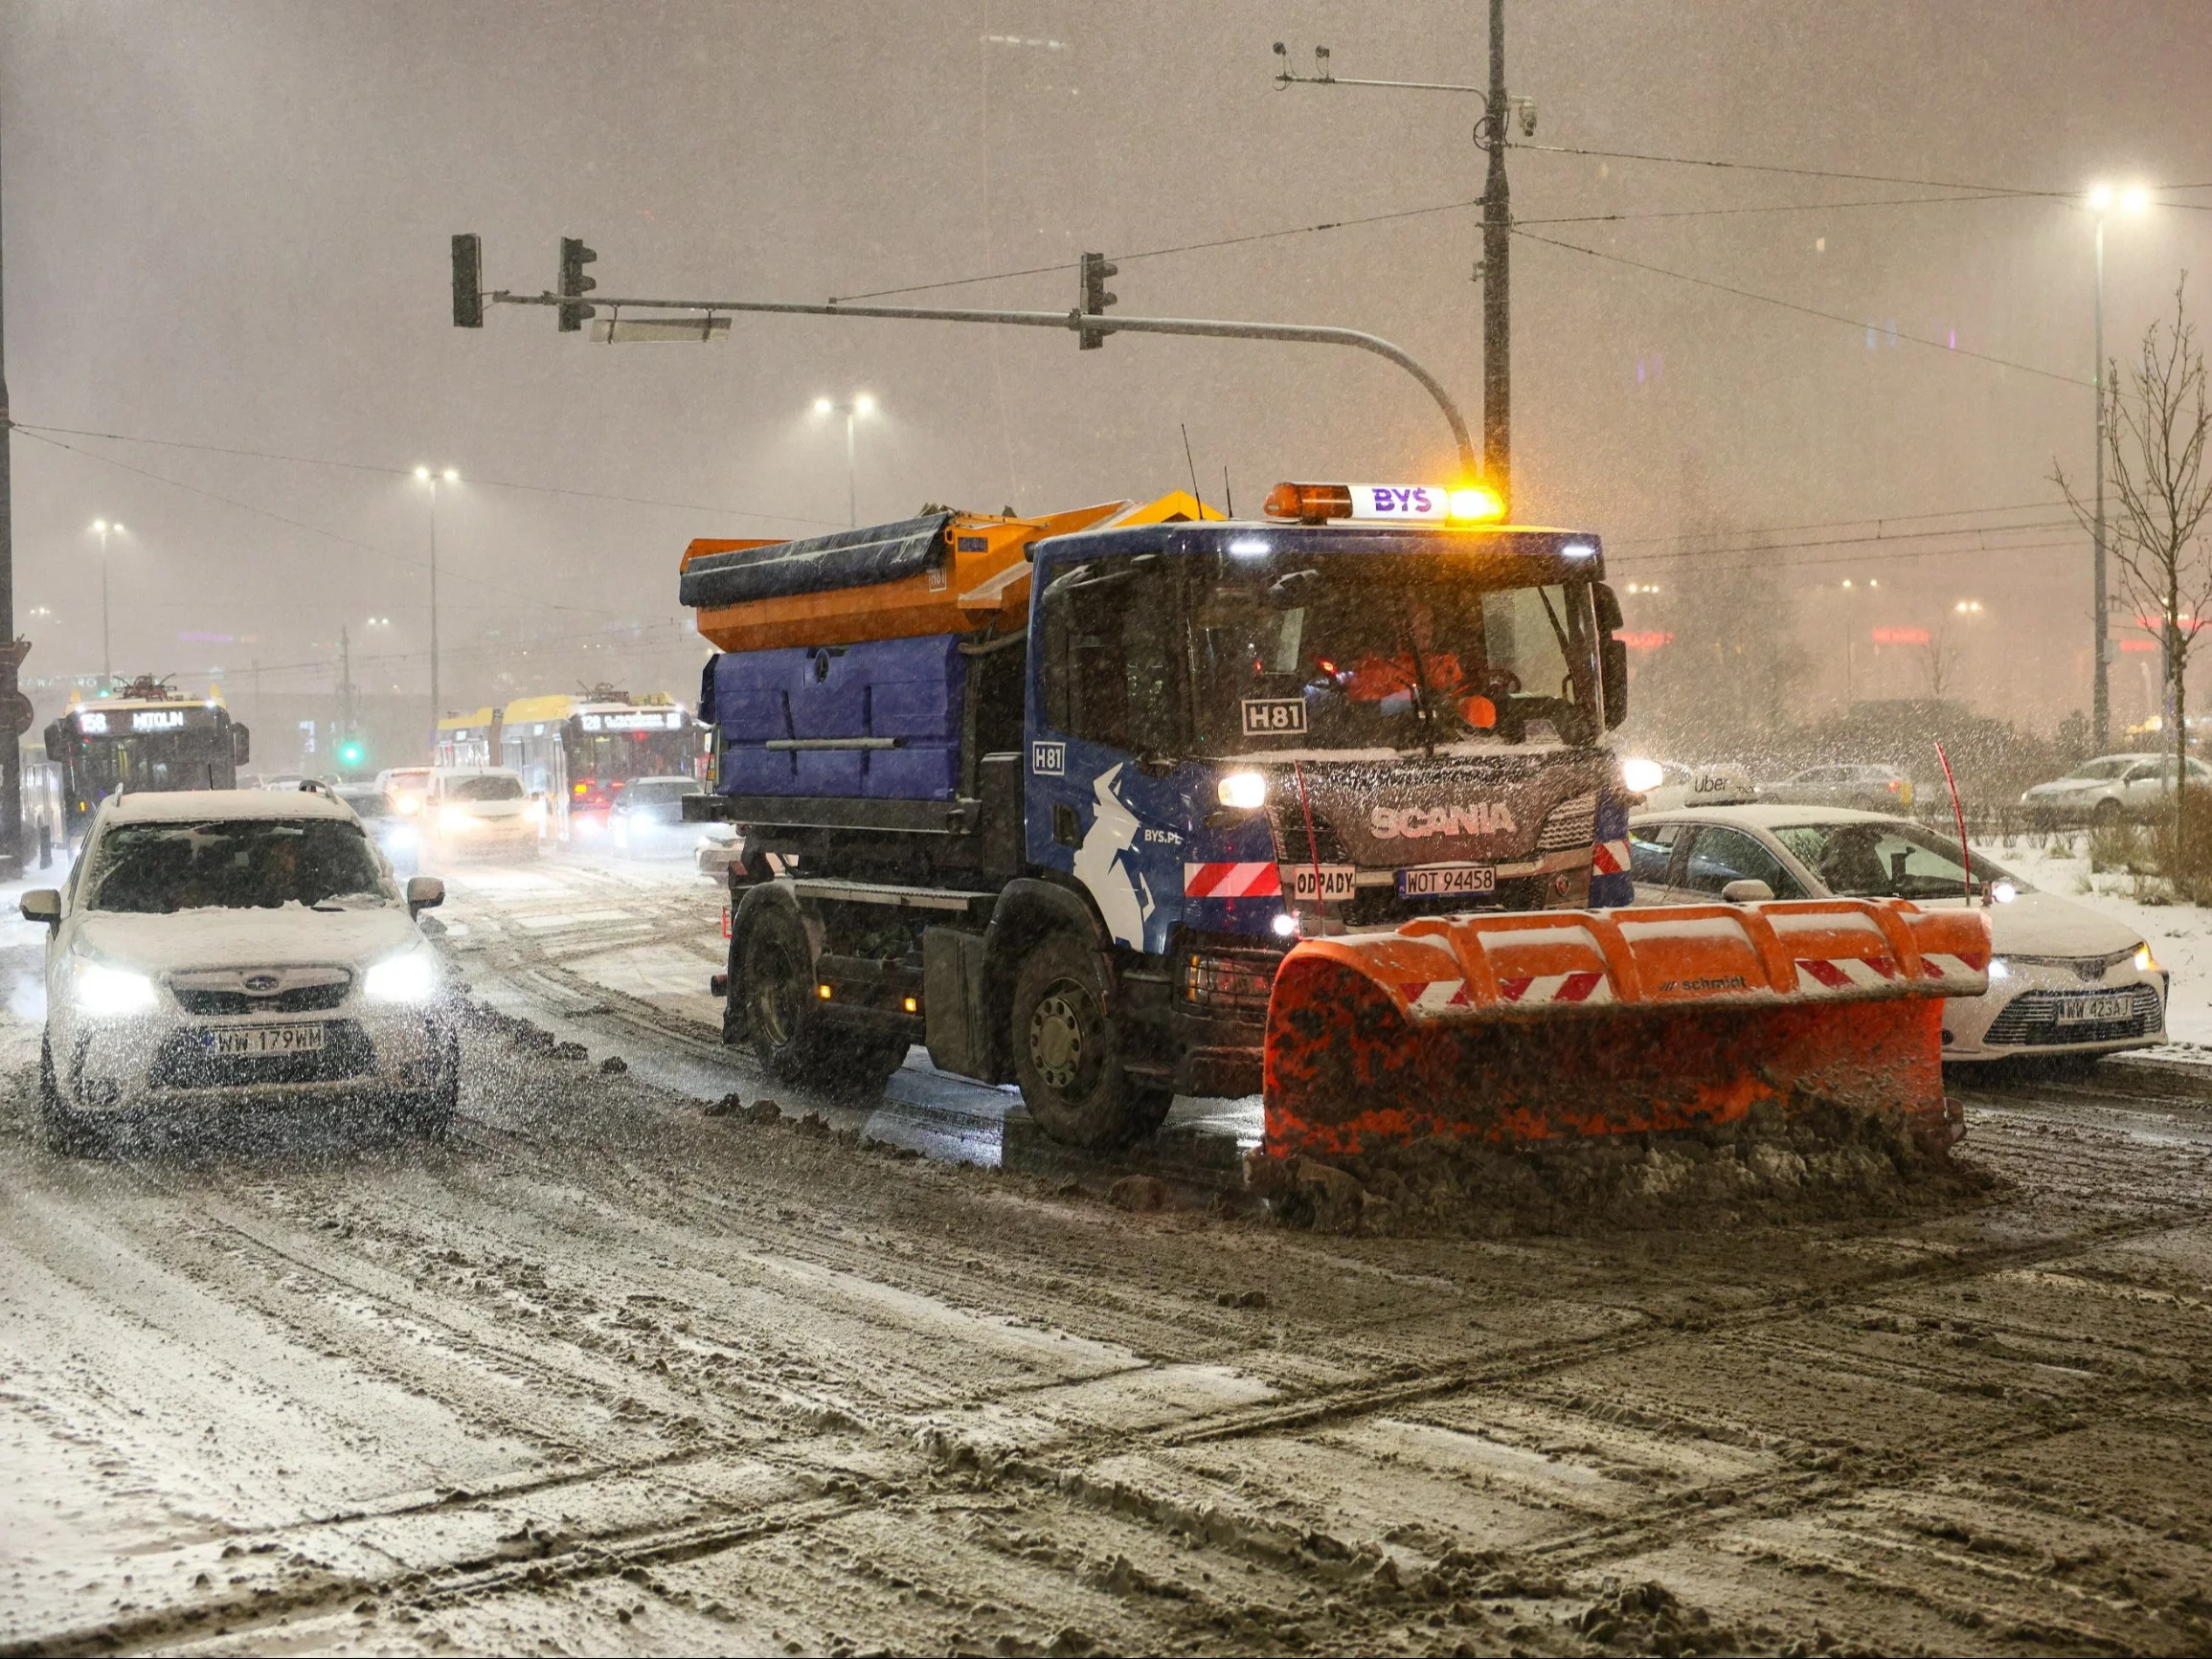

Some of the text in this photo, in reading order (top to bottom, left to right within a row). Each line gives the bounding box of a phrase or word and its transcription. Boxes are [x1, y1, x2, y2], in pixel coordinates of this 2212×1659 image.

[80, 714, 106, 732] 158
[1250, 706, 1300, 728] H81
[1035, 748, 1062, 769] H81
[1694, 775, 1727, 794] Uber
[1371, 802, 1517, 840] SCANIA
[1144, 829, 1183, 844] BYS.PL
[1297, 872, 1354, 894] ODPADY
[1408, 870, 1493, 893] WOT 94458
[1682, 975, 1748, 990] schmidt
[2067, 996, 2129, 1019] WW 423AJ
[219, 1028, 322, 1052] WW 179WM
